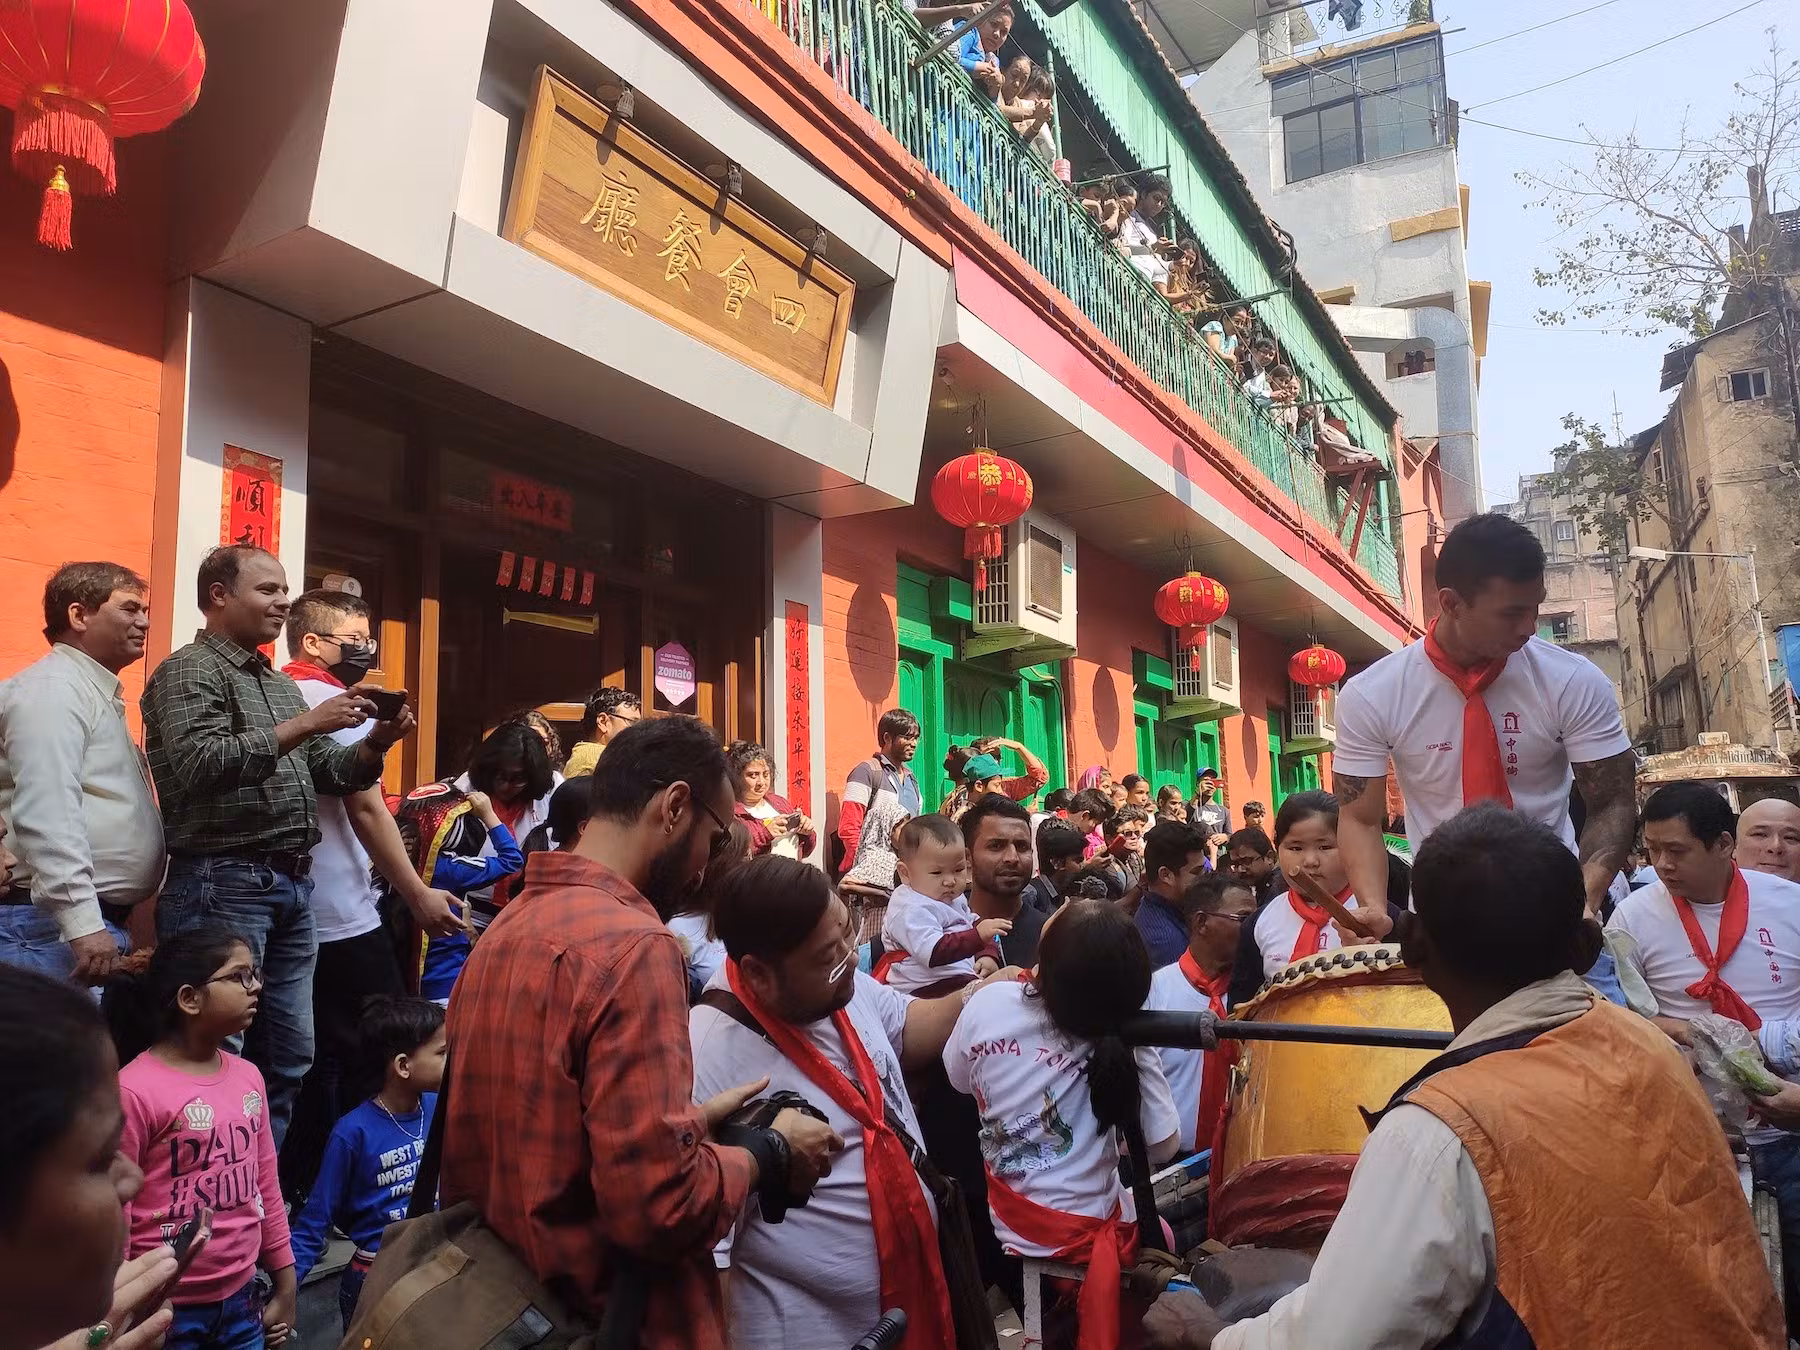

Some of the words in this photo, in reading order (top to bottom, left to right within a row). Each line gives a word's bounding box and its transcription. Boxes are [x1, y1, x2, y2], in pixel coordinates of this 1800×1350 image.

[658, 666, 692, 680] zomato
[380, 1144, 411, 1169] WEST
[390, 1180, 415, 1198] TOG
